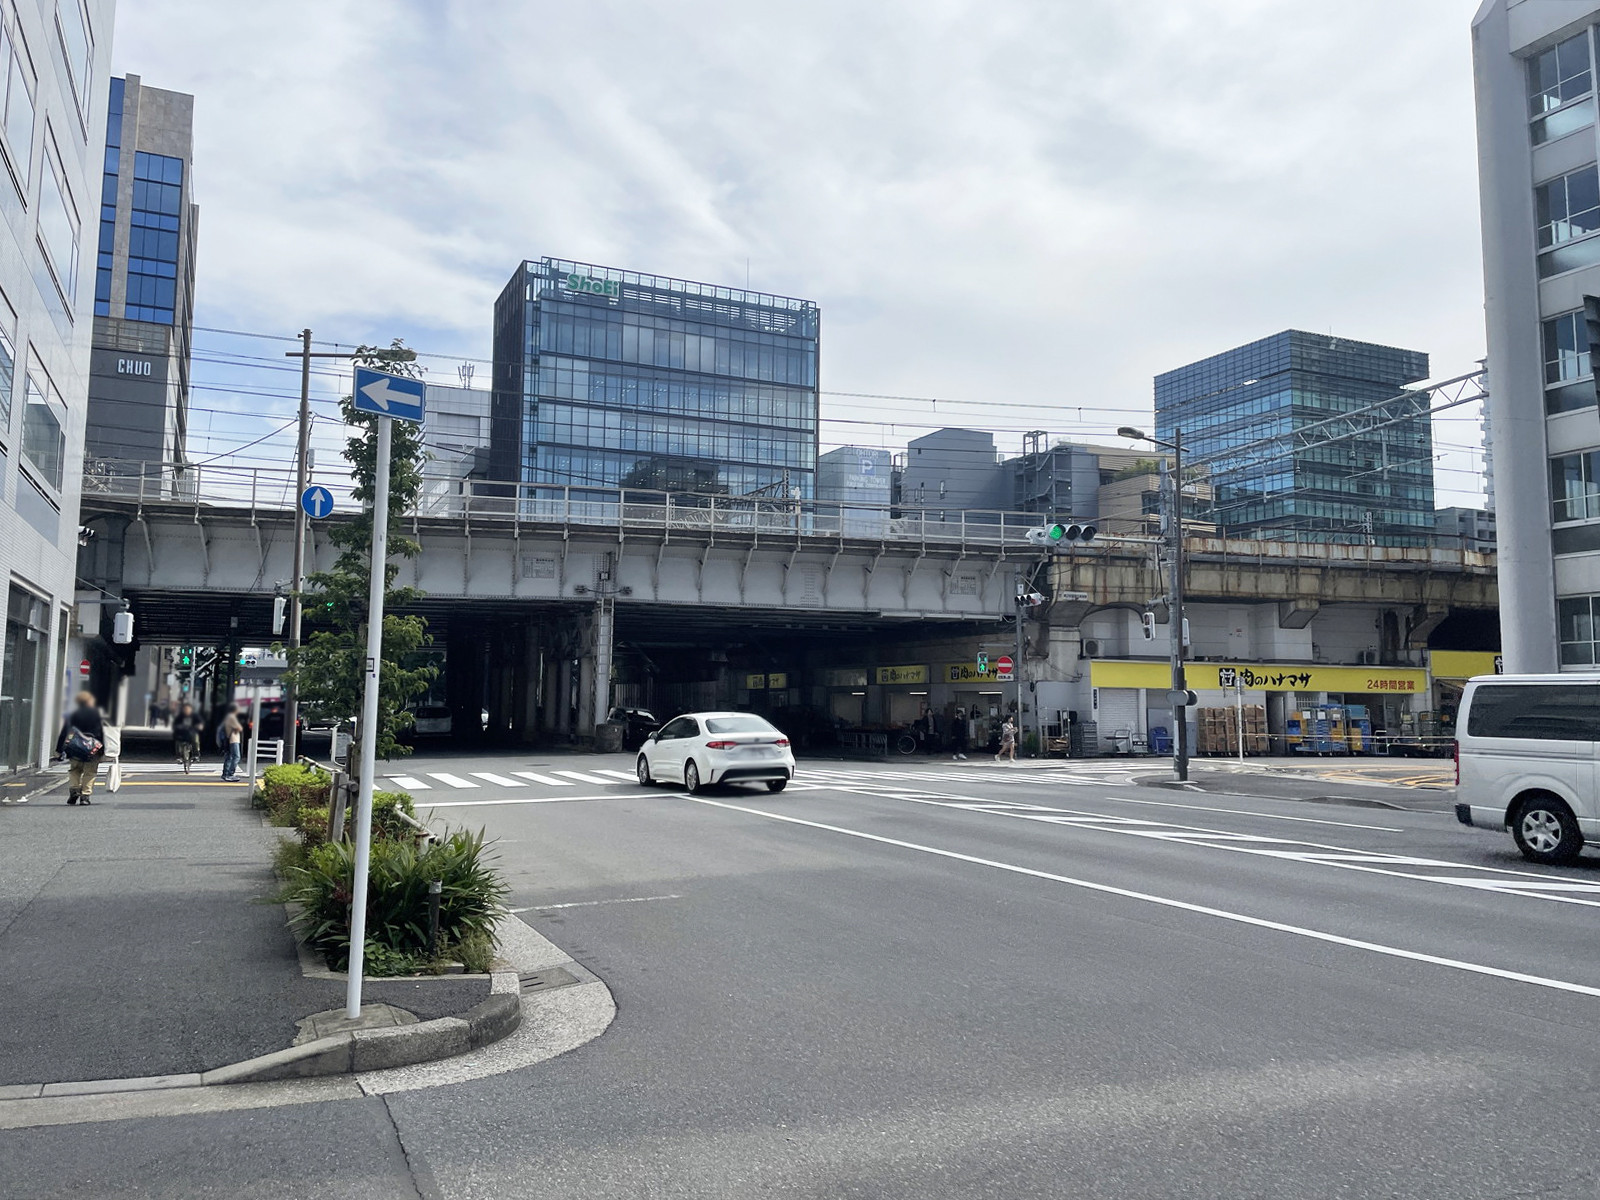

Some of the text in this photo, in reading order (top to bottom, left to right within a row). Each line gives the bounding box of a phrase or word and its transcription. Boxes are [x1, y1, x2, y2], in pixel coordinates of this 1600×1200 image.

[567, 273, 619, 297] ShoEi
[117, 358, 151, 376] CHUO
[861, 459, 873, 474] P
[1240, 668, 1312, 688] 肉のハナマサ
[1367, 679, 1415, 690] 24時間営業
